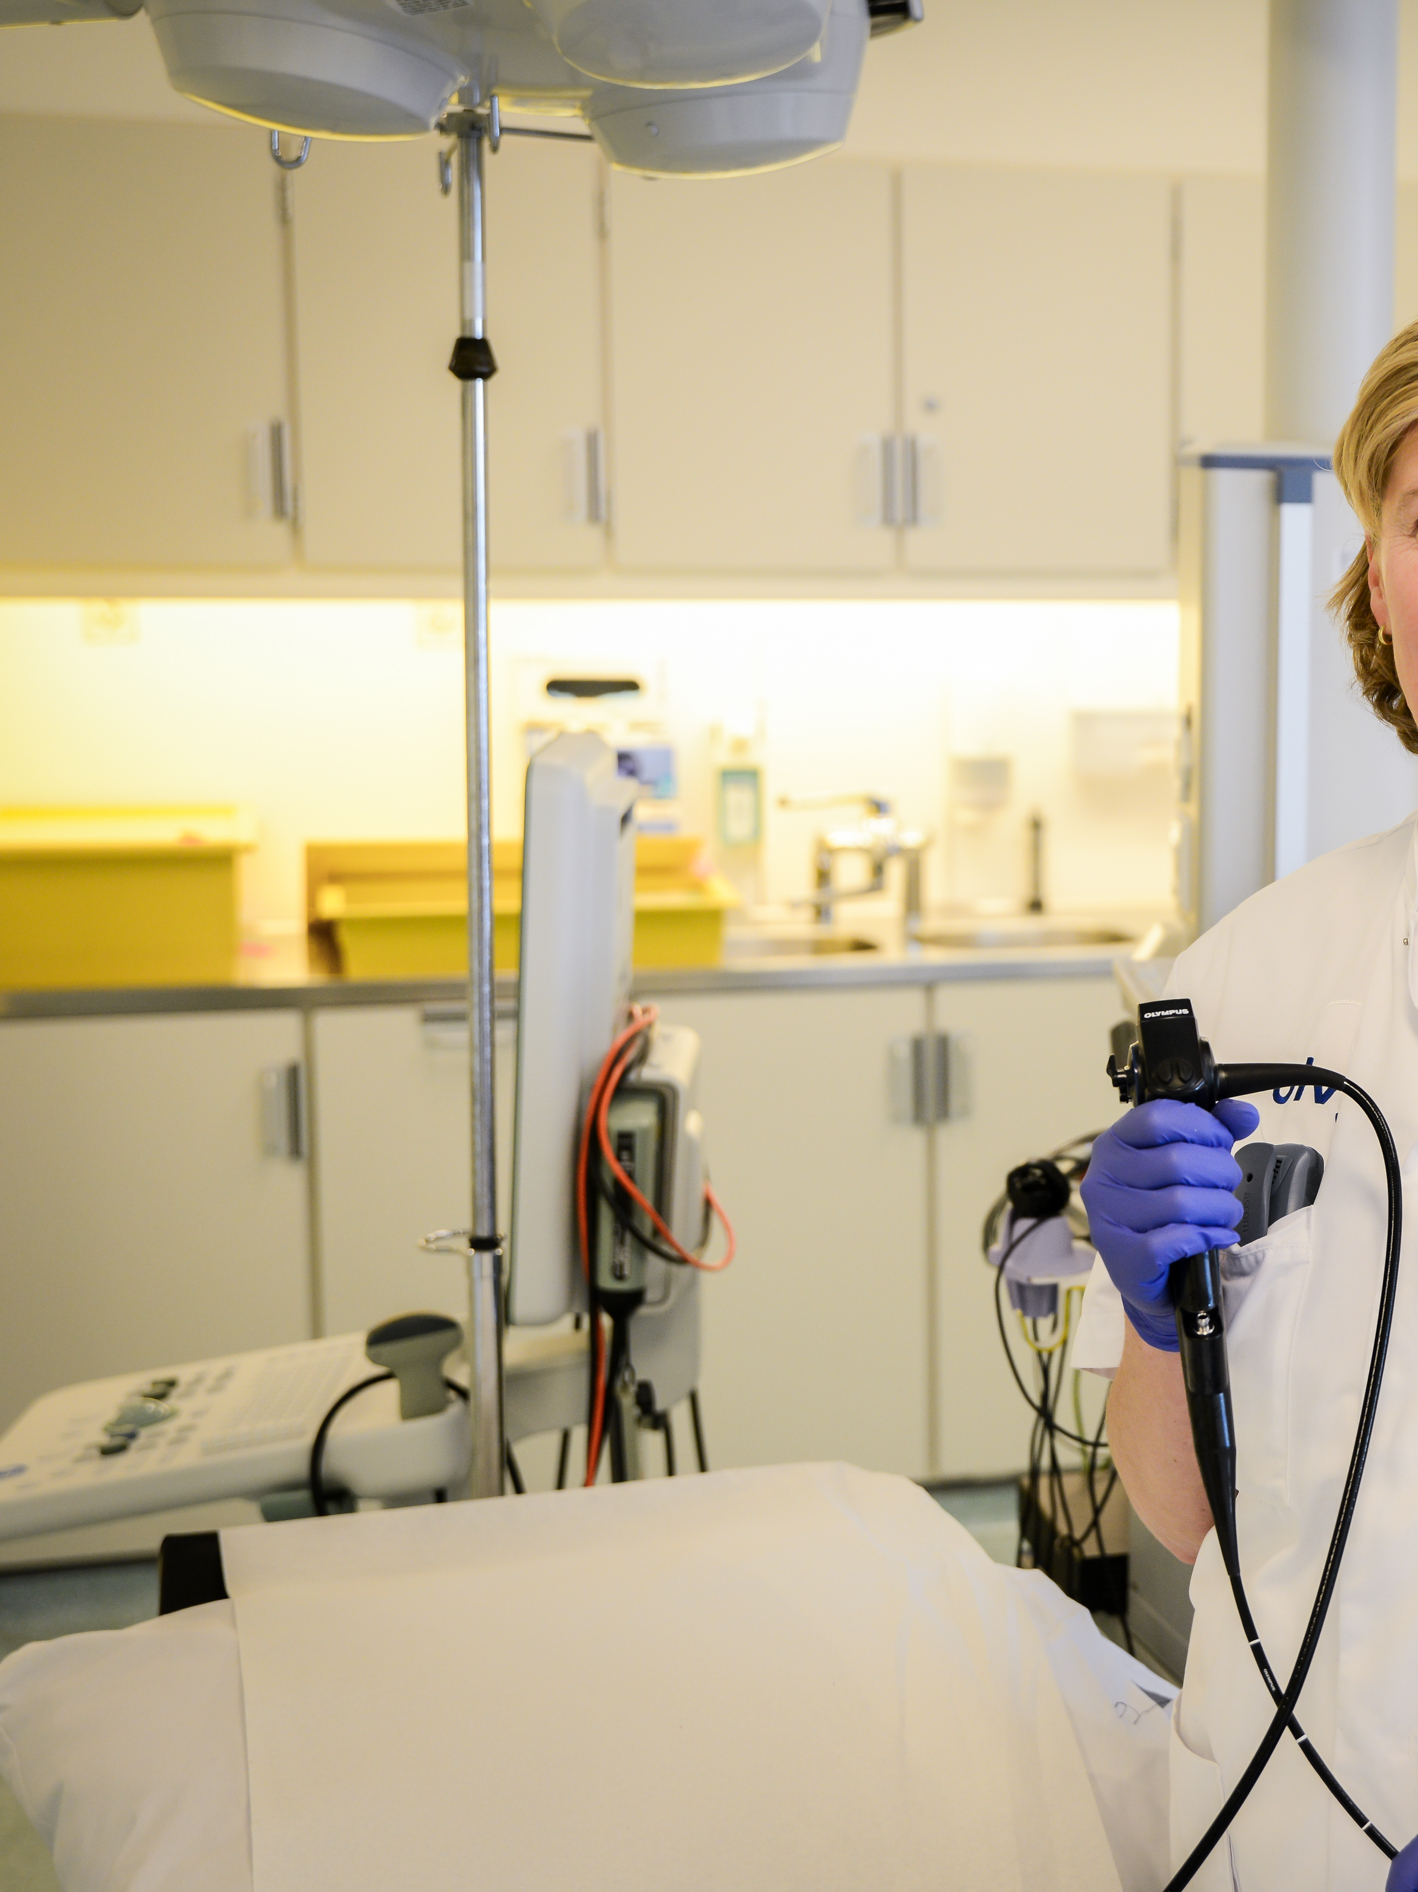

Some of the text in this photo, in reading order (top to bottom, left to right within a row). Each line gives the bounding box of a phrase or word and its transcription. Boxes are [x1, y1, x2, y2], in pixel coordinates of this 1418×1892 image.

[1143, 1008, 1190, 1019] OLYMPUS
[1272, 1056, 1339, 1123] olv
[1242, 1192, 1251, 1233] ascom
